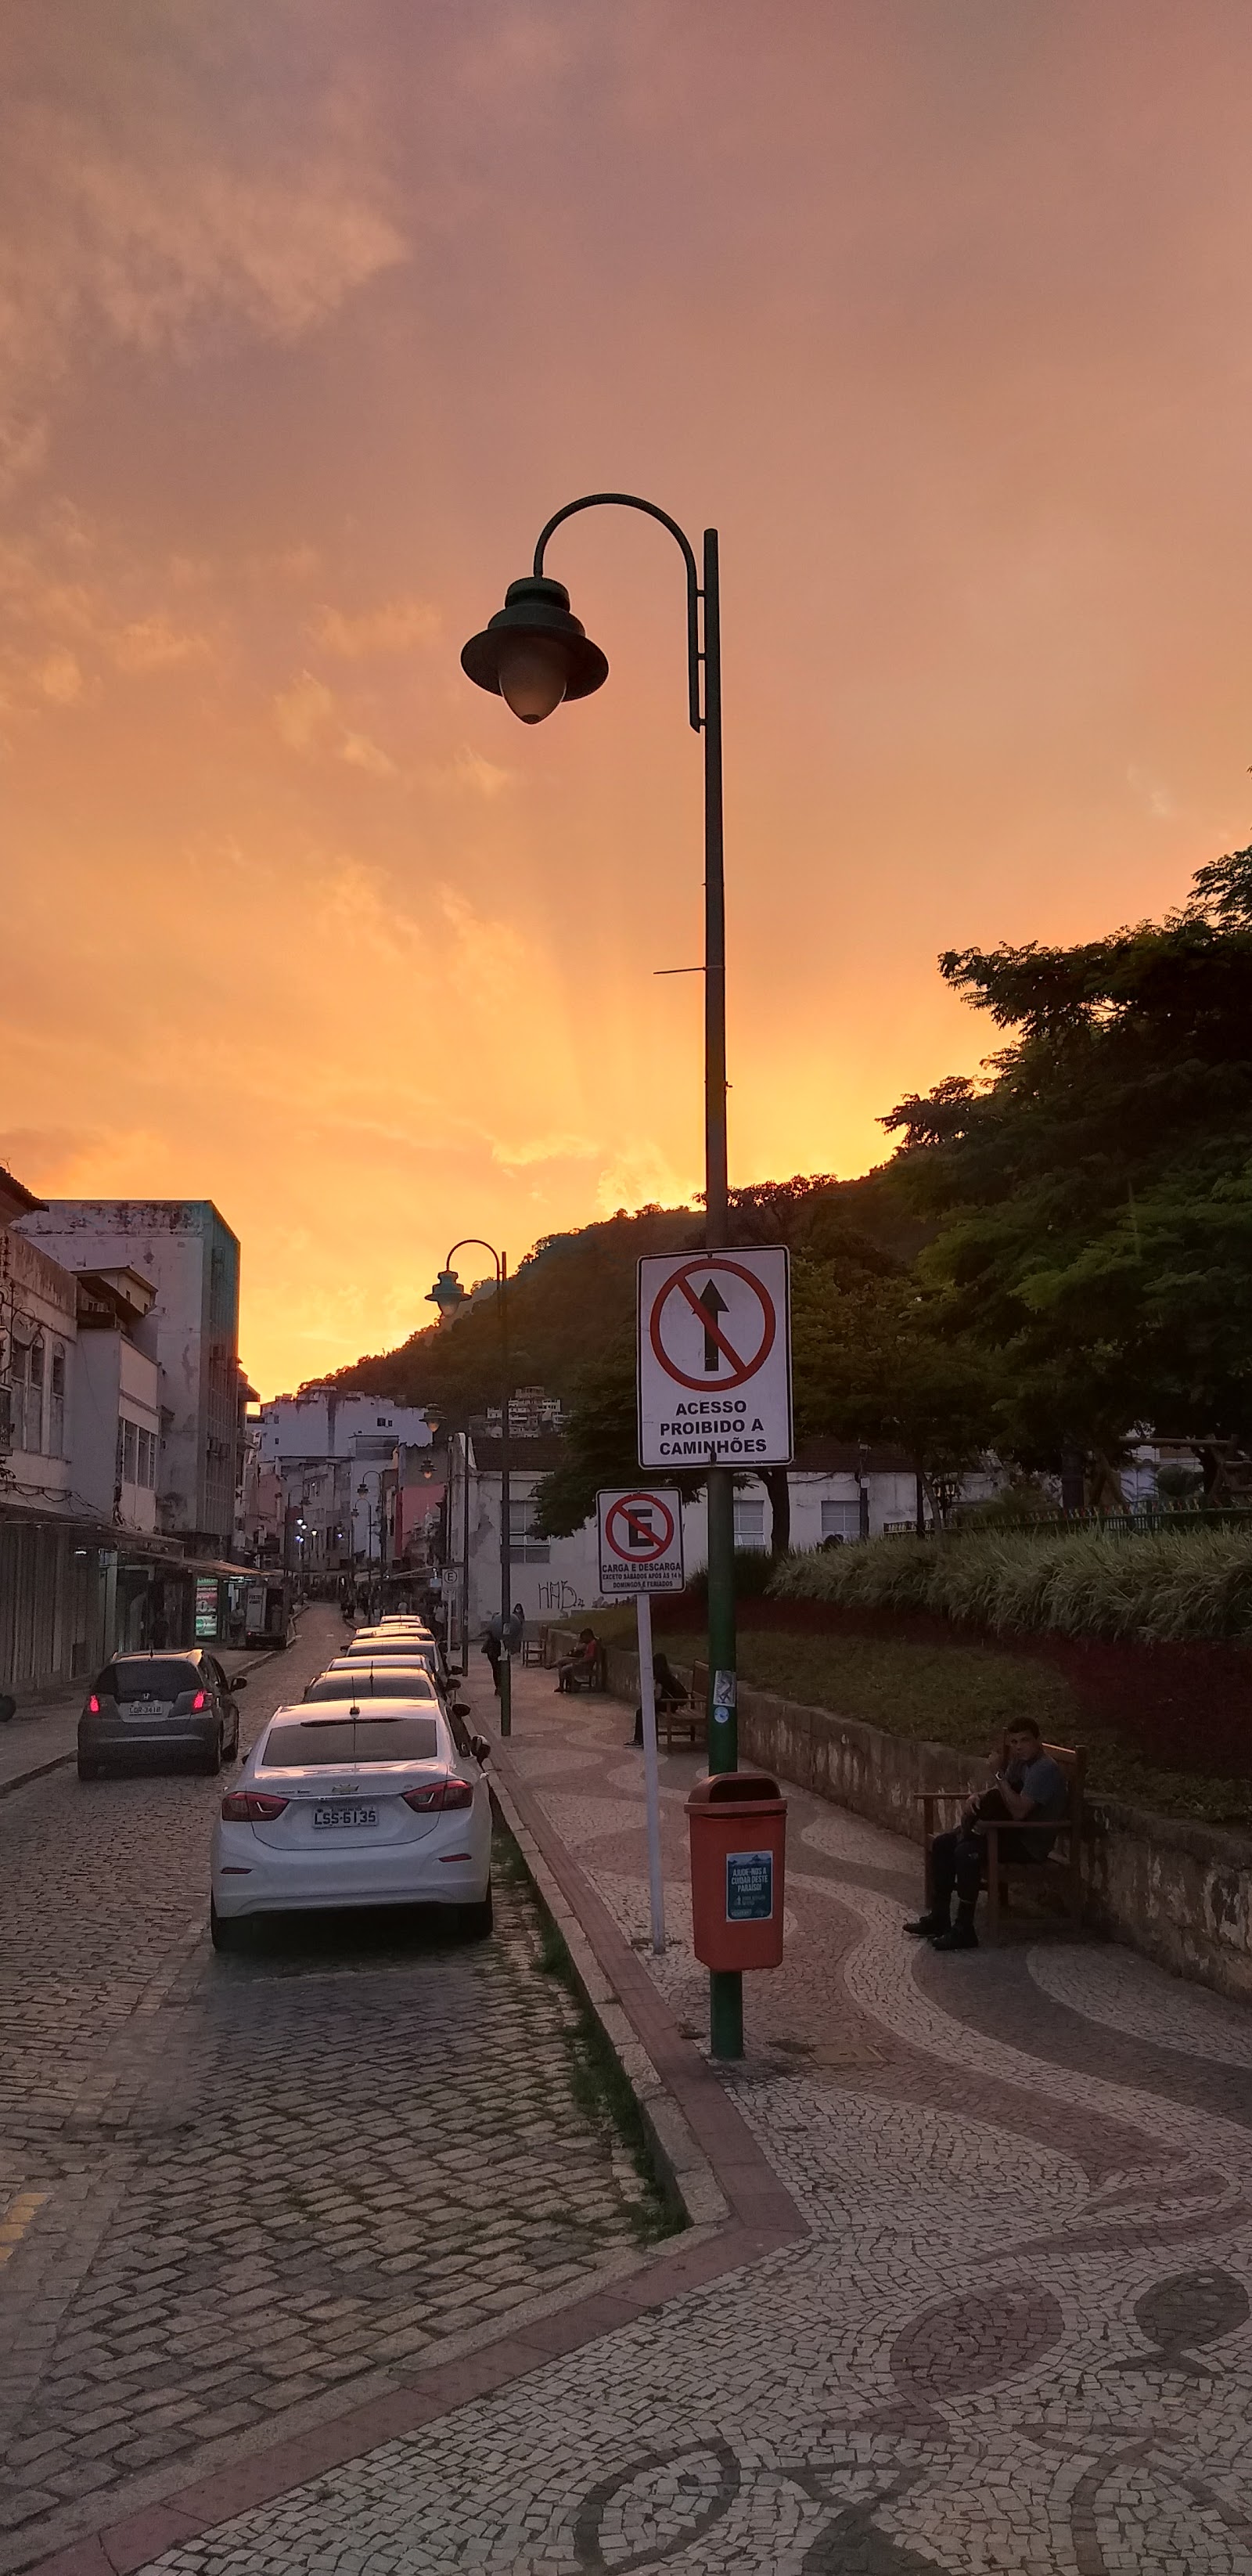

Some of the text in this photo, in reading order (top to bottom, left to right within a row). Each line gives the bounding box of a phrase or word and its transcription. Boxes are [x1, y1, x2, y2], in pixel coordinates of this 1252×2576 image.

[675, 1400, 747, 1416] ACESSO
[660, 1418, 765, 1436] PROIBIDO A
[659, 1437, 767, 1455] CAMINHÕES
[628, 1508, 654, 1547] E
[602, 1564, 629, 1573] CARGA
[639, 1562, 681, 1571] DESCARGA
[733, 1868, 762, 1876] AJUDE-NOS
